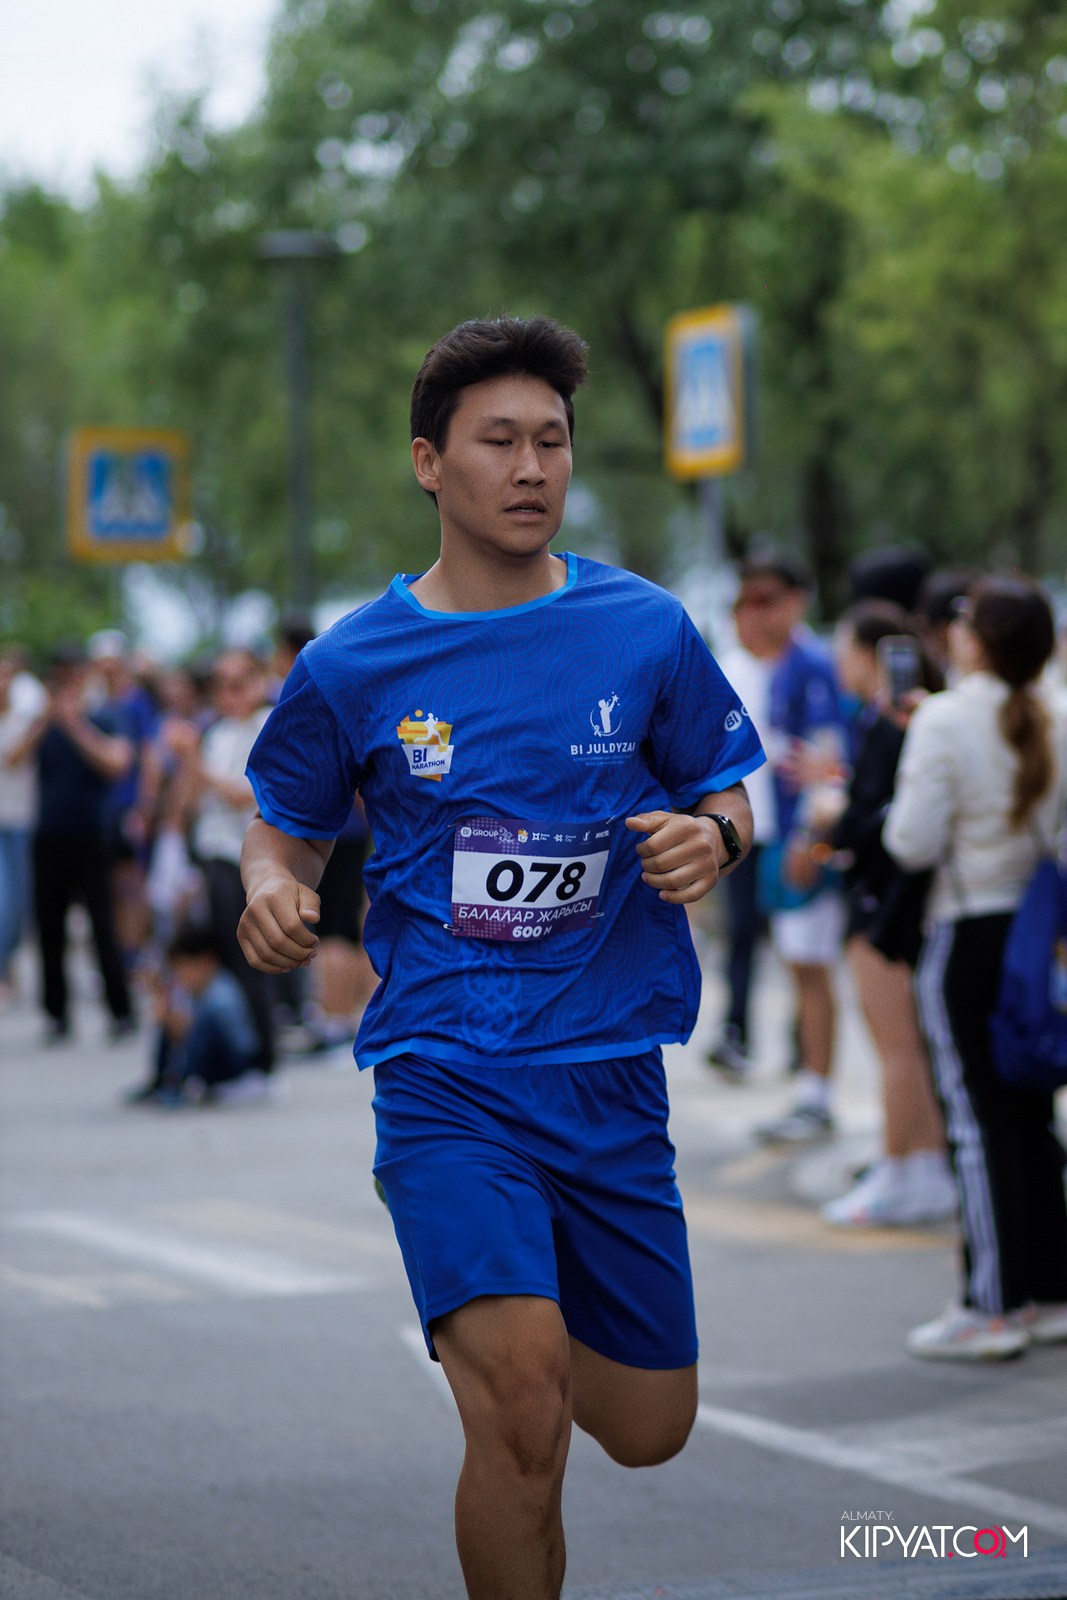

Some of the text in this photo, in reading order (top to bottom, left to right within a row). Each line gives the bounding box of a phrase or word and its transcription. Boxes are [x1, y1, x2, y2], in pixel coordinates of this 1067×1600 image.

[413, 748, 428, 763] BI
[570, 744, 583, 755] BI
[411, 759, 446, 770] MARATHON
[472, 829, 499, 838] GROUP
[486, 860, 586, 902] 078
[458, 899, 593, 923] БАЛАЛАР ЖАРЫСЫ
[512, 925, 543, 938] 600
